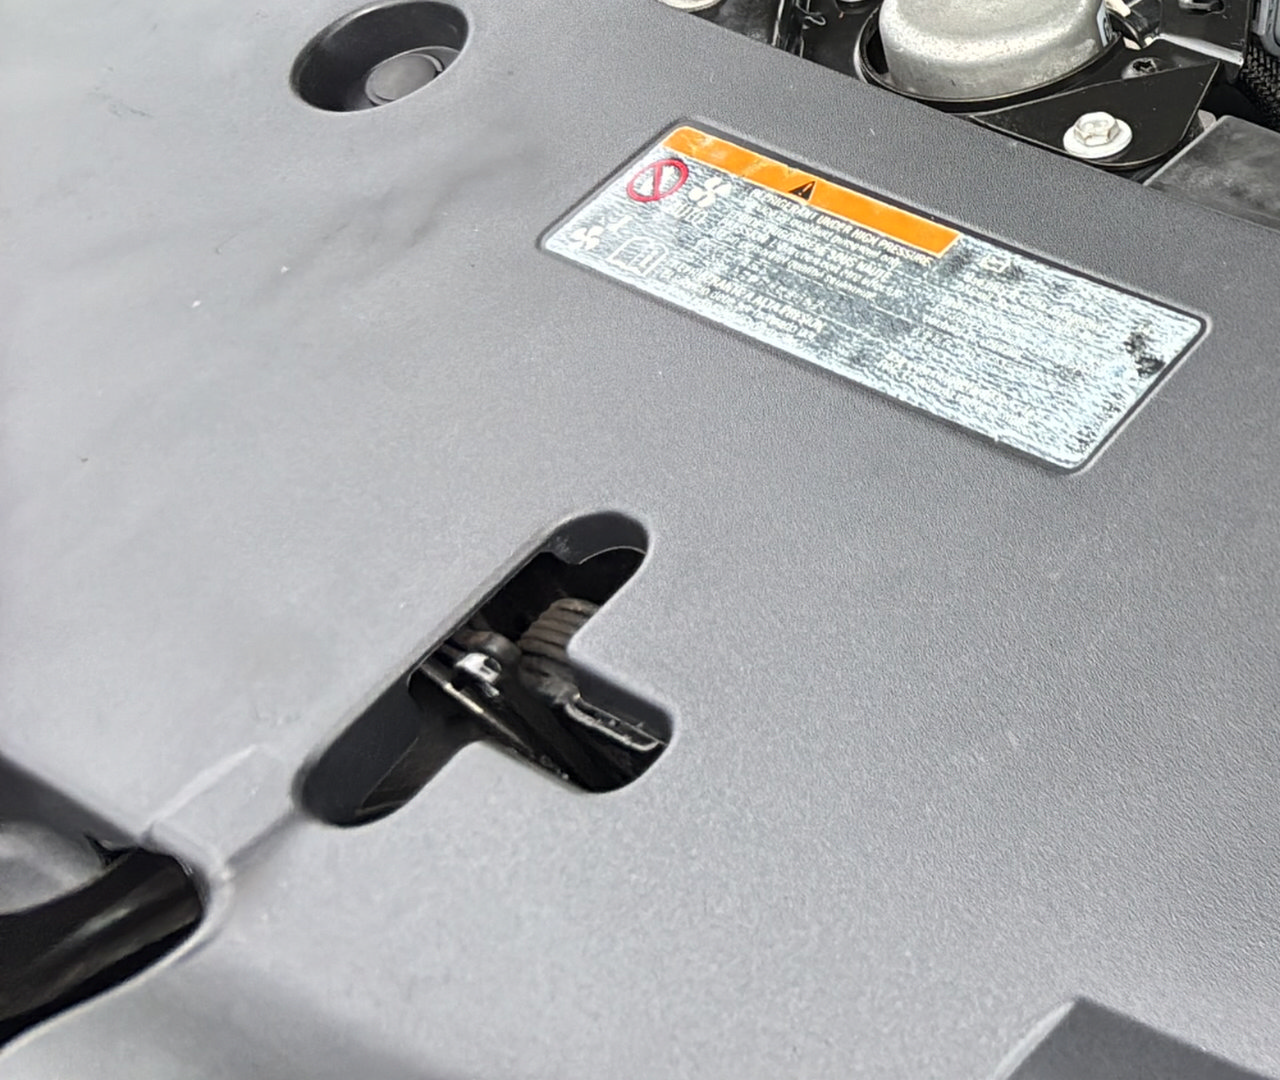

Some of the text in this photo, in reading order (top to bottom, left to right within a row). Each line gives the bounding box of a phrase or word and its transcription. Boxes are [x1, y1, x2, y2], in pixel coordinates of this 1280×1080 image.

[814, 214, 855, 234] UNDER
[849, 228, 881, 245] HIGH
[875, 238, 935, 267] PRESSURE
